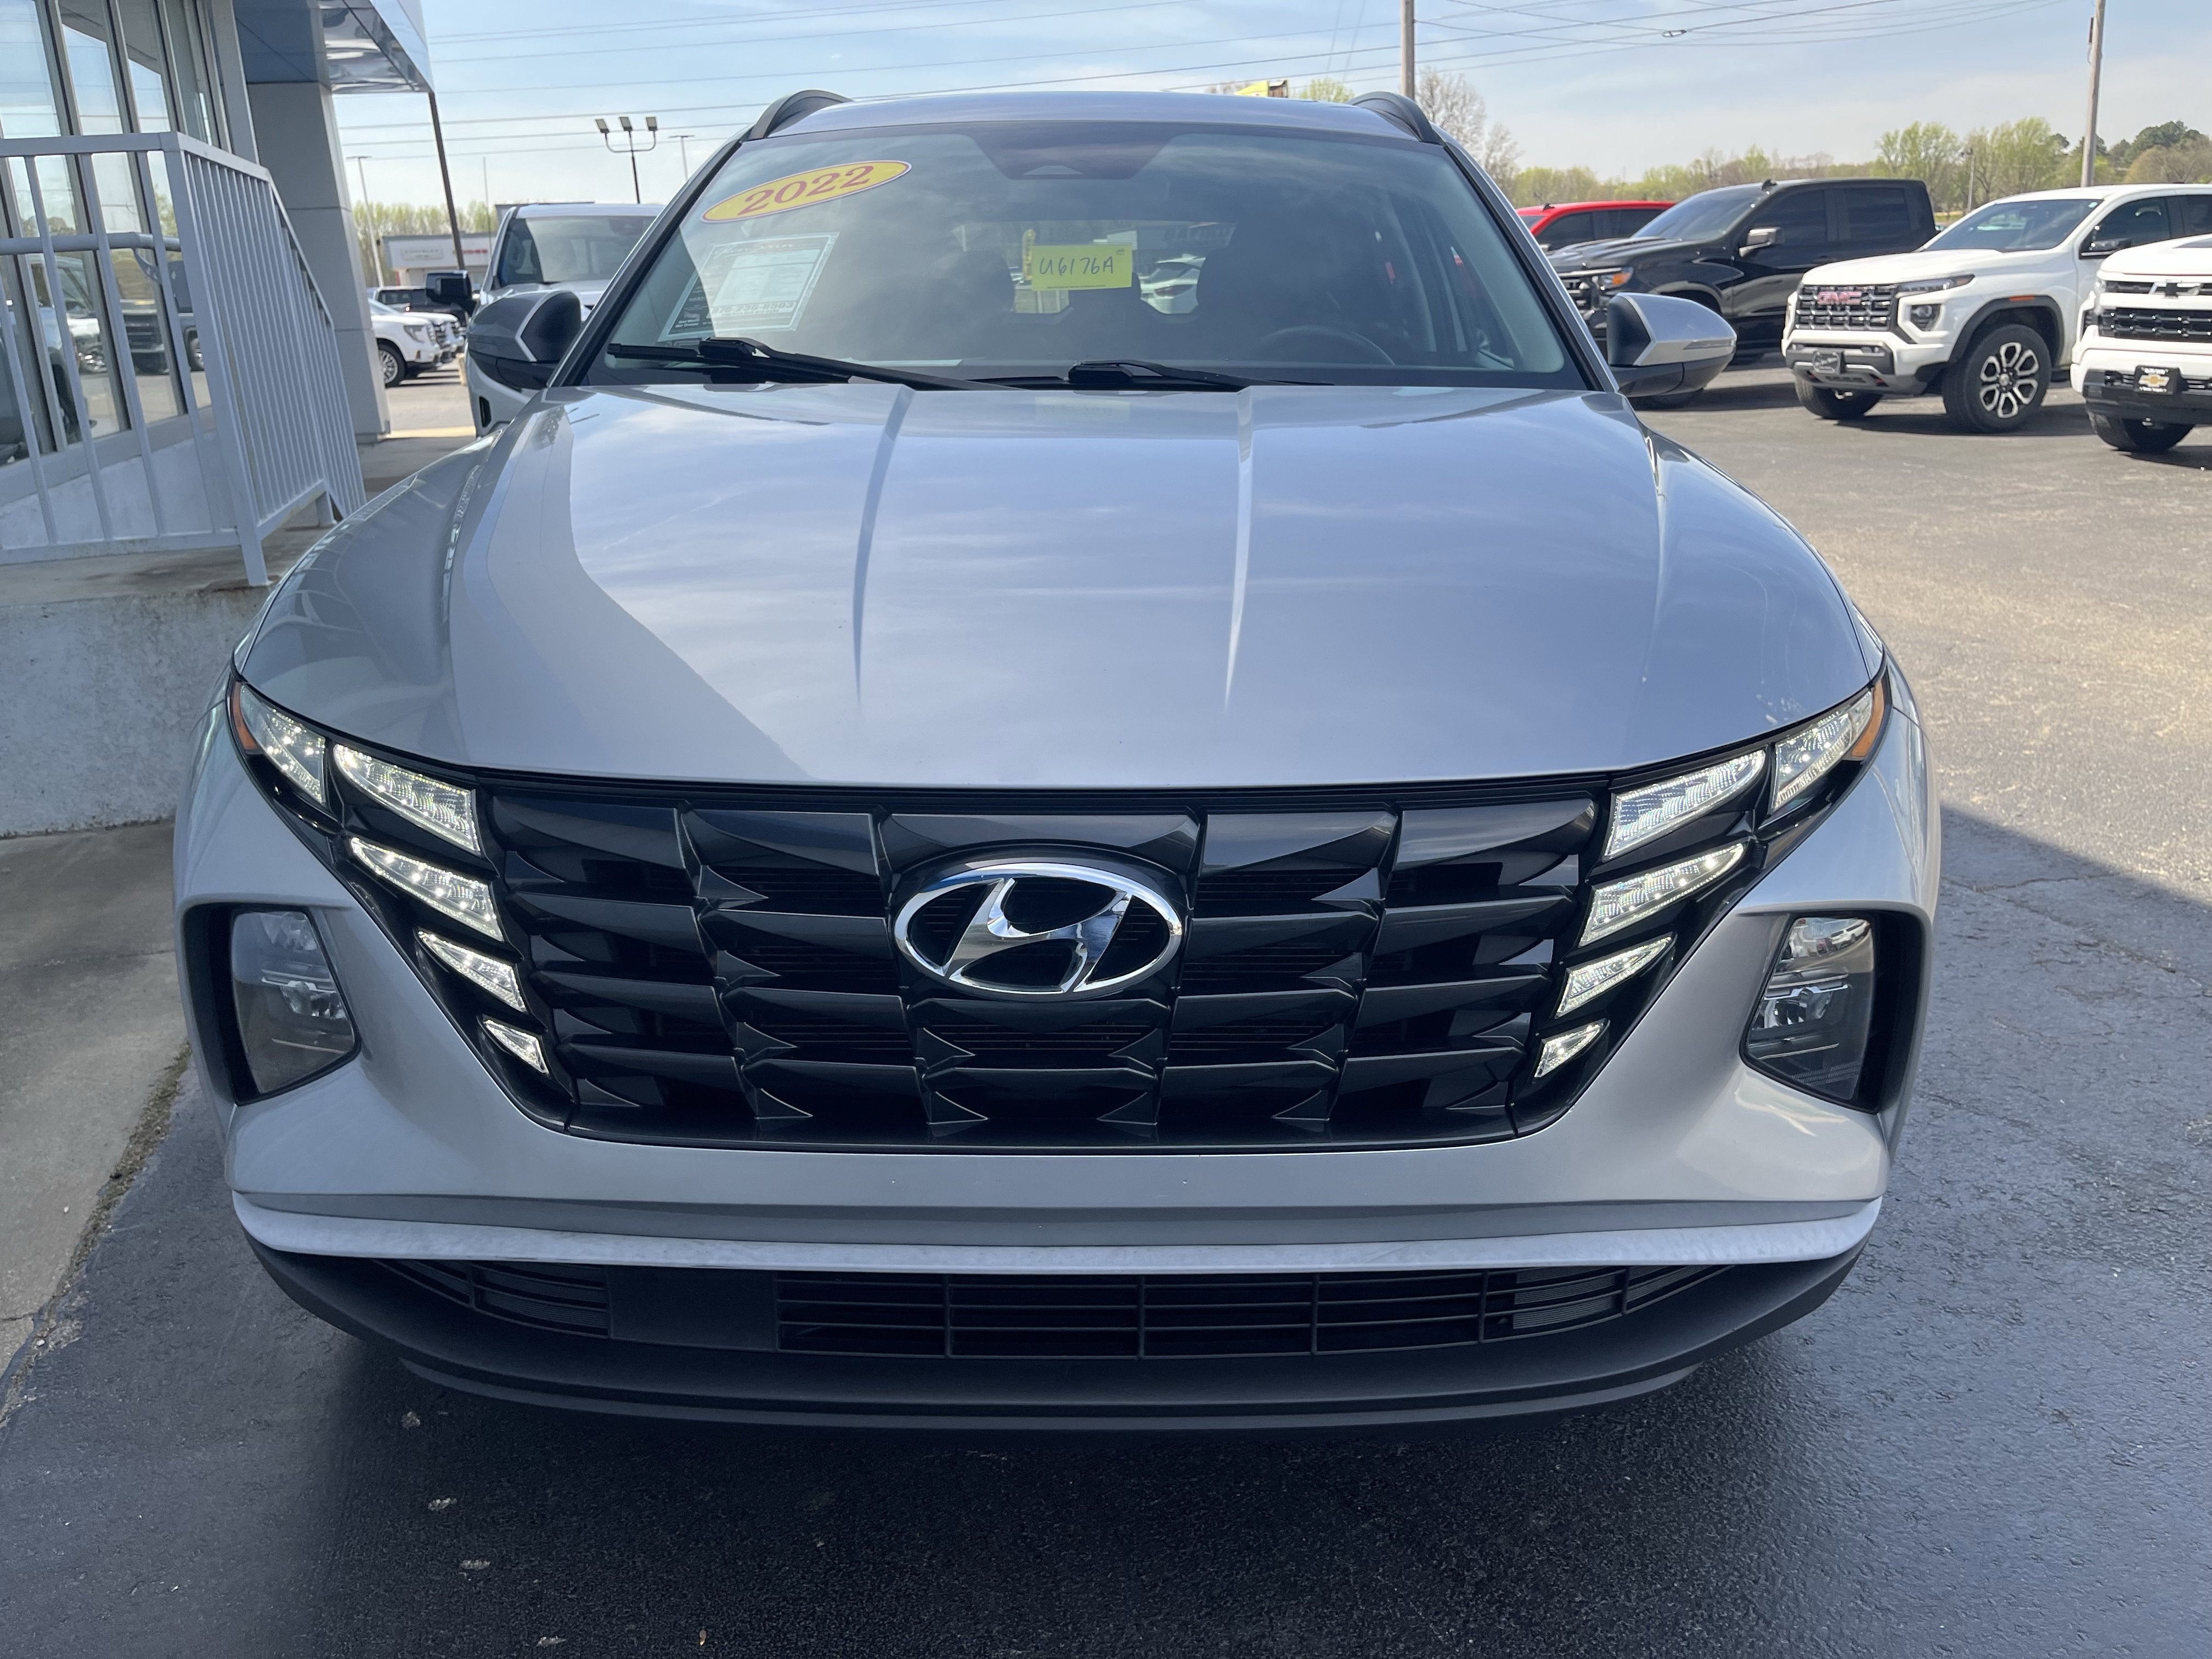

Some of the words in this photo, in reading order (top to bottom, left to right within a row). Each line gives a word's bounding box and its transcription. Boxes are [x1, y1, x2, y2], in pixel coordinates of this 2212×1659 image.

[737, 166, 874, 216] 2022
[1039, 256, 1114, 276] U6176A
[1817, 291, 1862, 305] GMC
